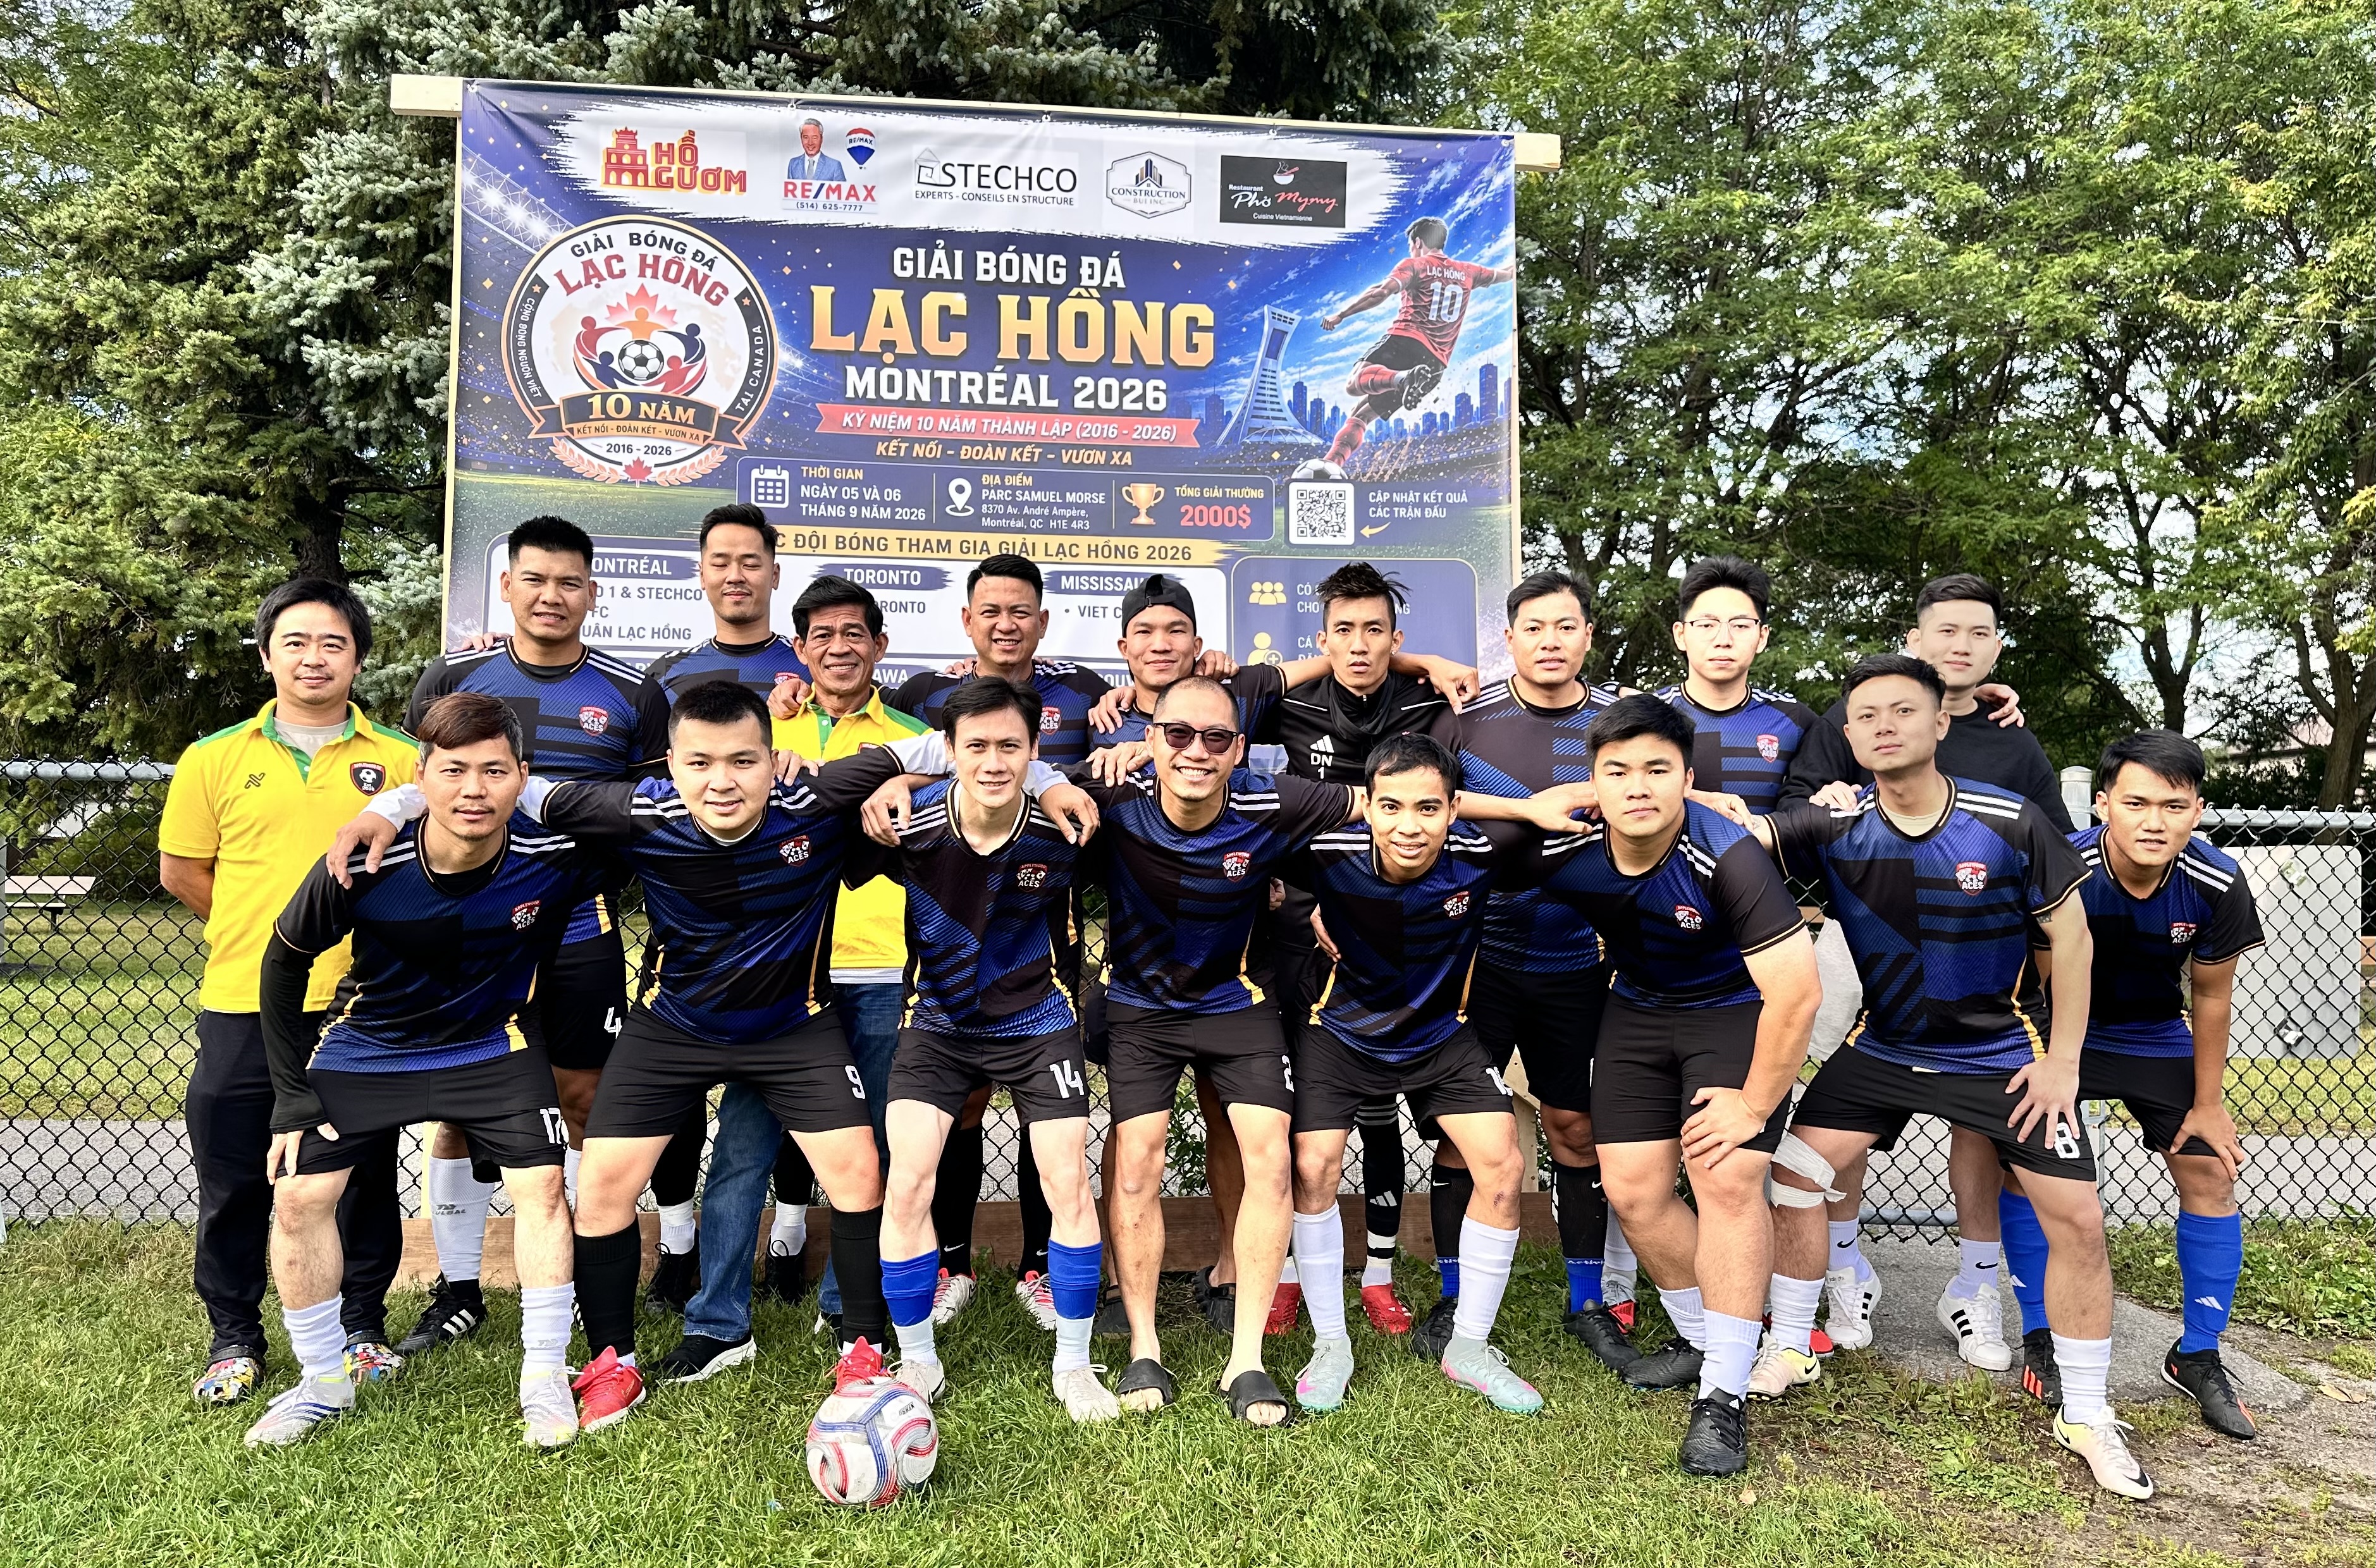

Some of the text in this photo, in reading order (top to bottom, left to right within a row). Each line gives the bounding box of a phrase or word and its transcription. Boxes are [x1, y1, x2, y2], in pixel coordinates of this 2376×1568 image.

[655, 130, 698, 166] HỒ
[849, 137, 873, 145] RE/MAX
[655, 166, 747, 192] GƯƠM
[940, 163, 1076, 193] STECHCO
[784, 181, 877, 202] RE/MAX
[915, 190, 953, 200] EXPERTS
[962, 192, 1004, 202] CONSEILS
[1007, 194, 1019, 203] EN
[1021, 195, 1074, 205] STRUCTURE
[1112, 188, 1186, 199] CONSTRUCTION
[1231, 191, 1271, 209] Phở
[796, 202, 863, 212] (514) 625-7777
[1275, 214, 1313, 222] Vietnamienne
[571, 230, 718, 272] GIẢI BÓNG ĐÁ
[892, 239, 1126, 288] GIẢI BÓNG ĐÁ
[554, 253, 729, 307] LẠC HỒNG
[1427, 266, 1442, 279] LẠC
[1429, 281, 1464, 323] 10
[809, 285, 1215, 368] LẠC HỒNG
[749, 325, 765, 387] CANADA
[844, 365, 1167, 412] MONTRÉAL 2026
[588, 393, 696, 425] 10 NĂM
[577, 424, 593, 434] KẾT
[594, 424, 609, 434] NỐI
[616, 423, 639, 434] ĐOÀN
[641, 424, 657, 435] KẾT
[689, 431, 700, 442] XA
[842, 410, 868, 428] KỶ
[870, 412, 913, 434] NIỆM
[917, 415, 934, 431] 10
[938, 414, 978, 434] NĂM
[981, 414, 1037, 436] THÀNH
[1040, 416, 1072, 439] LẬP
[1076, 420, 1120, 440] (2016
[1132, 424, 1177, 442] 2026)
[606, 443, 633, 455] 2016
[644, 444, 672, 456] 2026
[876, 438, 910, 458] KẾT
[911, 438, 942, 458] NỐI
[960, 441, 1007, 462] ĐOÀN
[1010, 441, 1043, 463] KẾT
[1061, 446, 1107, 466] VƯƠN
[1110, 451, 1133, 466] XA
[801, 465, 863, 480] THỜI GIAN
[982, 470, 1033, 487] ĐỊA ĐIỂM
[801, 484, 902, 501] NGÀY 05 VÀ 06
[982, 489, 1106, 505] PARC SAMUEL MORSE
[1174, 484, 1264, 499] TỔNG GIẢI THƯỞNG
[1369, 487, 1468, 505] CẬP NHẬT KẾT QUẢ
[800, 502, 926, 521] THÁNG 9 NĂM 2026
[982, 503, 1089, 520] 8370 Av. André Ampère,
[1181, 505, 1252, 529] 2000$
[1369, 503, 1447, 520] CÁC TRẬN ĐẤU
[982, 516, 1090, 530] Montréal, QC H1E 4R3
[793, 530, 827, 553] ĐỘI
[835, 532, 889, 552] BÓNG
[896, 537, 952, 554] THAM
[959, 539, 992, 555] GIA
[999, 534, 1037, 558] GIẢI
[1044, 541, 1080, 561] LẠC
[1088, 539, 1139, 561] HỒNG
[1146, 545, 1192, 561] 2026
[591, 556, 672, 575] ONTRÉAL
[844, 568, 921, 585] TORONTO
[609, 586, 615, 598] 1
[620, 586, 632, 599] &
[637, 587, 703, 601] STECHCO
[1297, 582, 1312, 596] CÓ
[875, 600, 926, 614] RONTO
[1078, 605, 1108, 618] VIET
[1297, 601, 1320, 613] CHO
[582, 623, 692, 641] UÂN LẠC HỒNG
[1298, 634, 1313, 648] CÁ
[583, 723, 604, 732] ACES
[1310, 752, 1333, 767] DN
[1317, 766, 1325, 780] 1
[787, 851, 809, 864] ACES
[1226, 868, 1246, 878] ACES
[1961, 881, 1985, 890] ACES
[1449, 905, 1468, 917] ACES
[516, 917, 536, 930] ACES
[603, 1007, 623, 1040] 4
[844, 1065, 866, 1099] 9
[1049, 1059, 1085, 1099] 14
[539, 1107, 562, 1144] 17
[2053, 1122, 2081, 1159] 8
